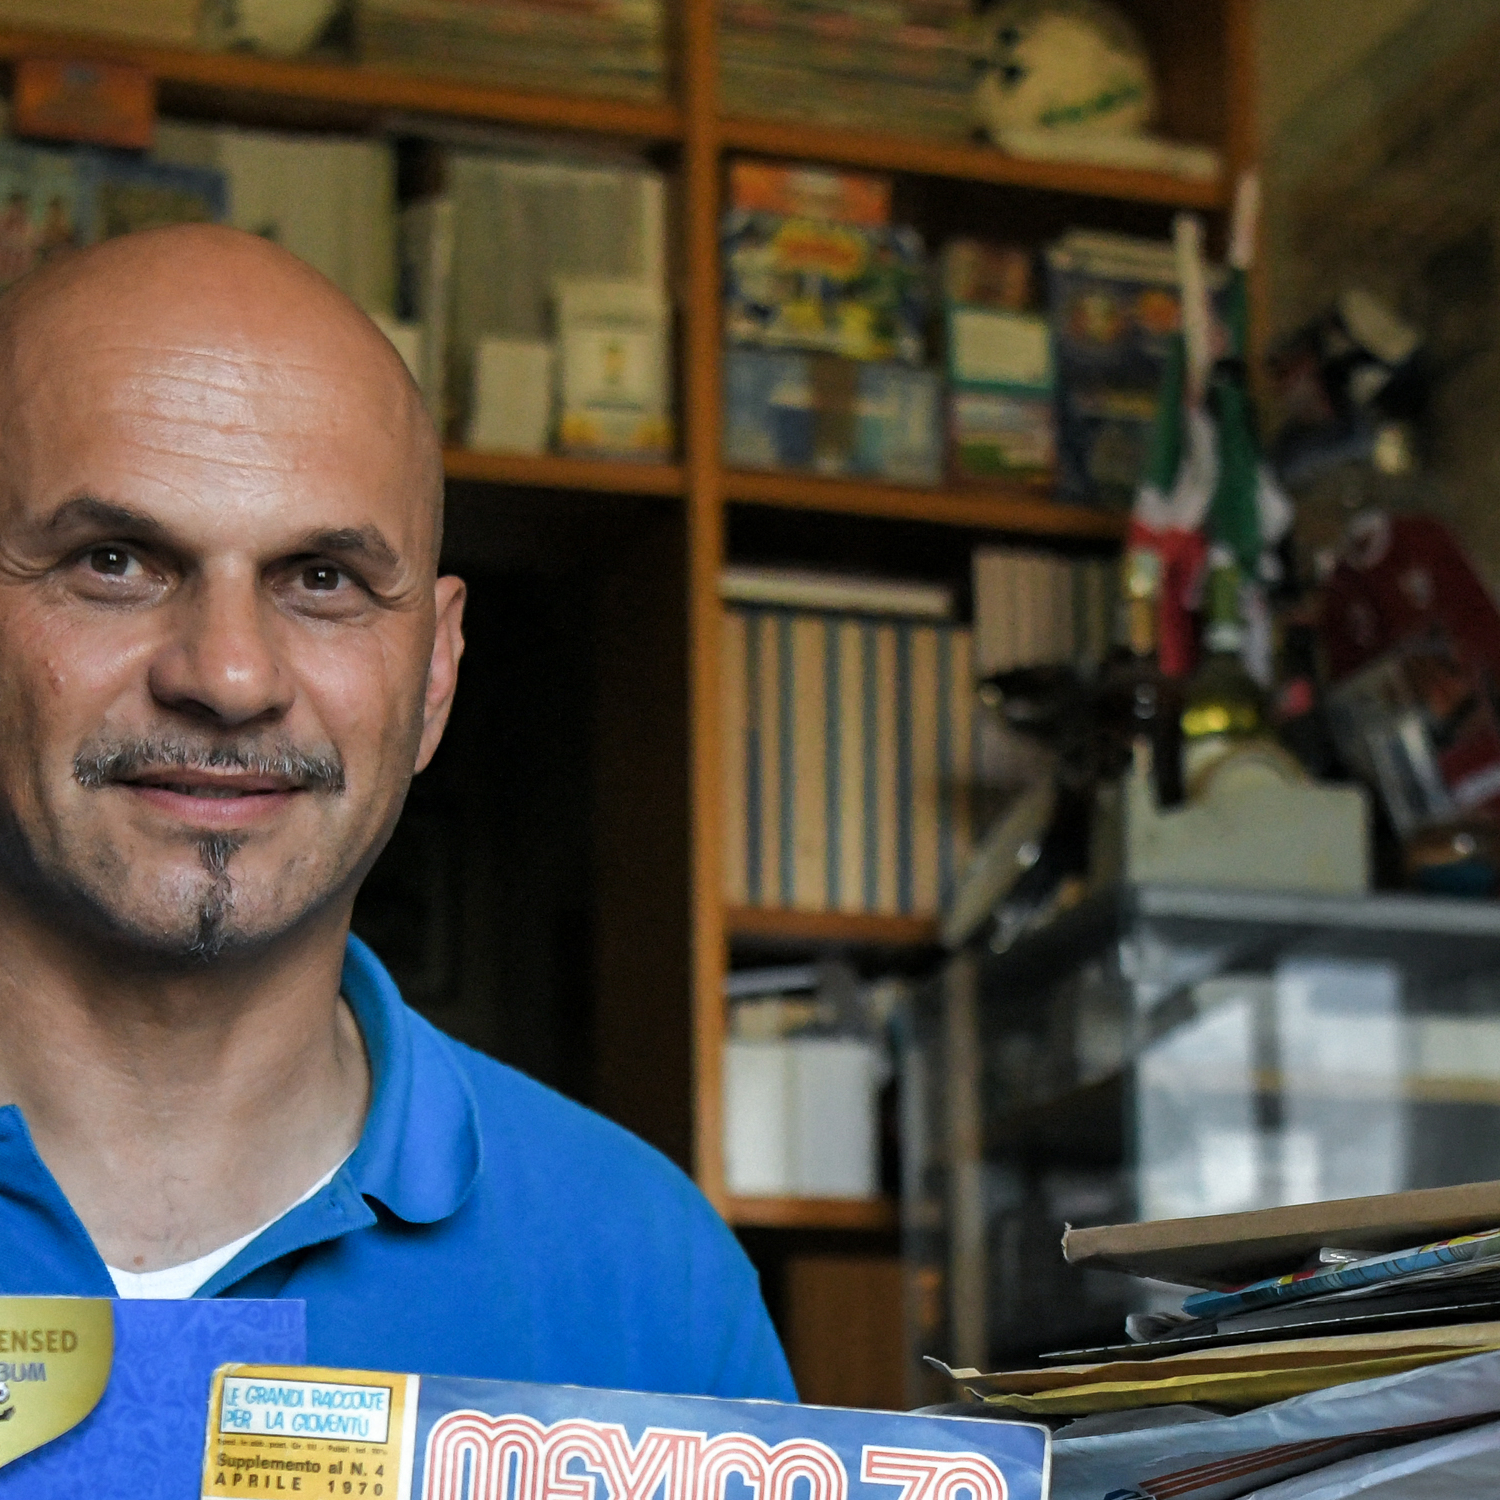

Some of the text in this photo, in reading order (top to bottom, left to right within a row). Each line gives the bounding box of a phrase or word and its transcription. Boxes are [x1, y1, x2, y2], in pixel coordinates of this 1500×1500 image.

[245, 1385, 304, 1408] GRANDI
[223, 1410, 253, 1429] PER
[266, 1411, 284, 1430] LA
[216, 1453, 384, 1477] Supplemento al N. 4
[215, 1472, 384, 1497] APRILE 1970
